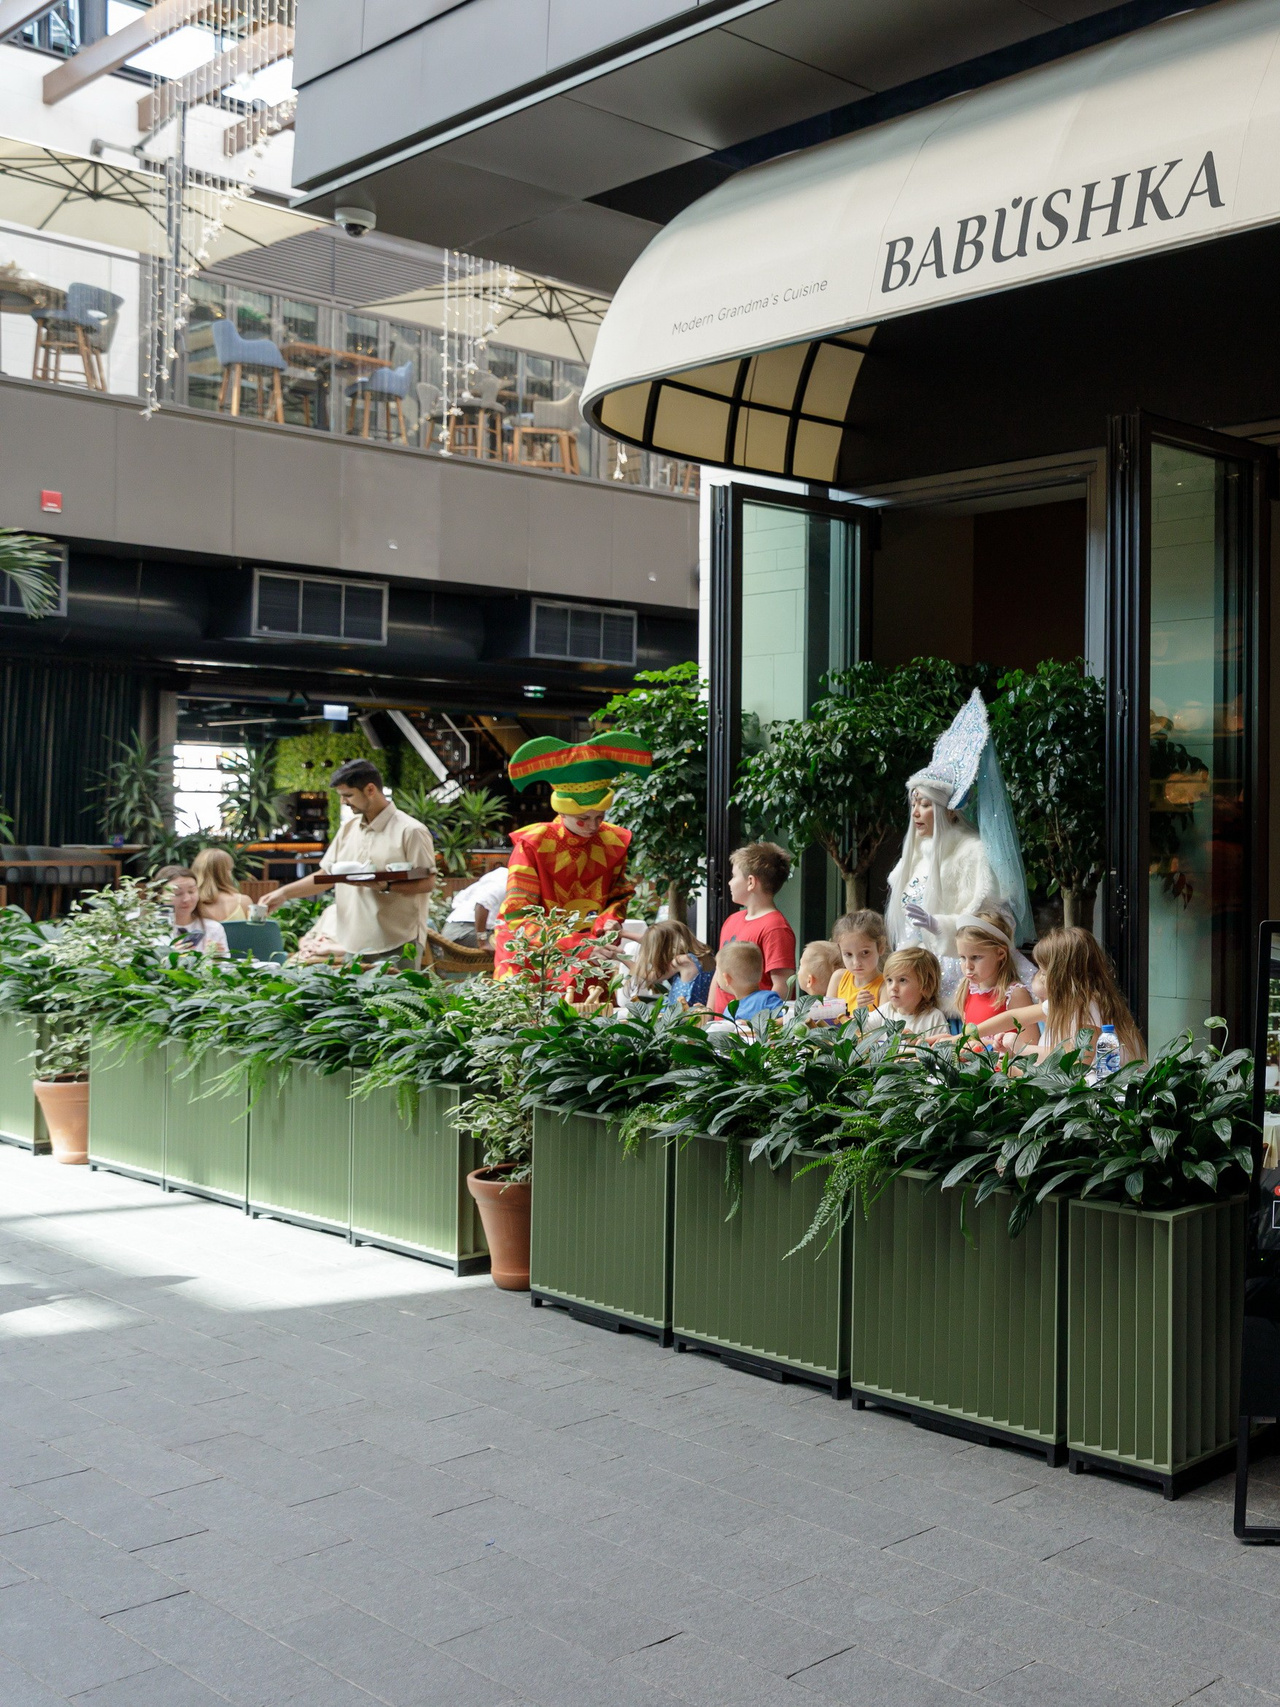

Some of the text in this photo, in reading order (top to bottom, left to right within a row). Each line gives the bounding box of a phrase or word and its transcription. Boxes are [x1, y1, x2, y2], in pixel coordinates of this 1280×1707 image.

[671, 279, 828, 335] Modern Grandma's Cuisine
